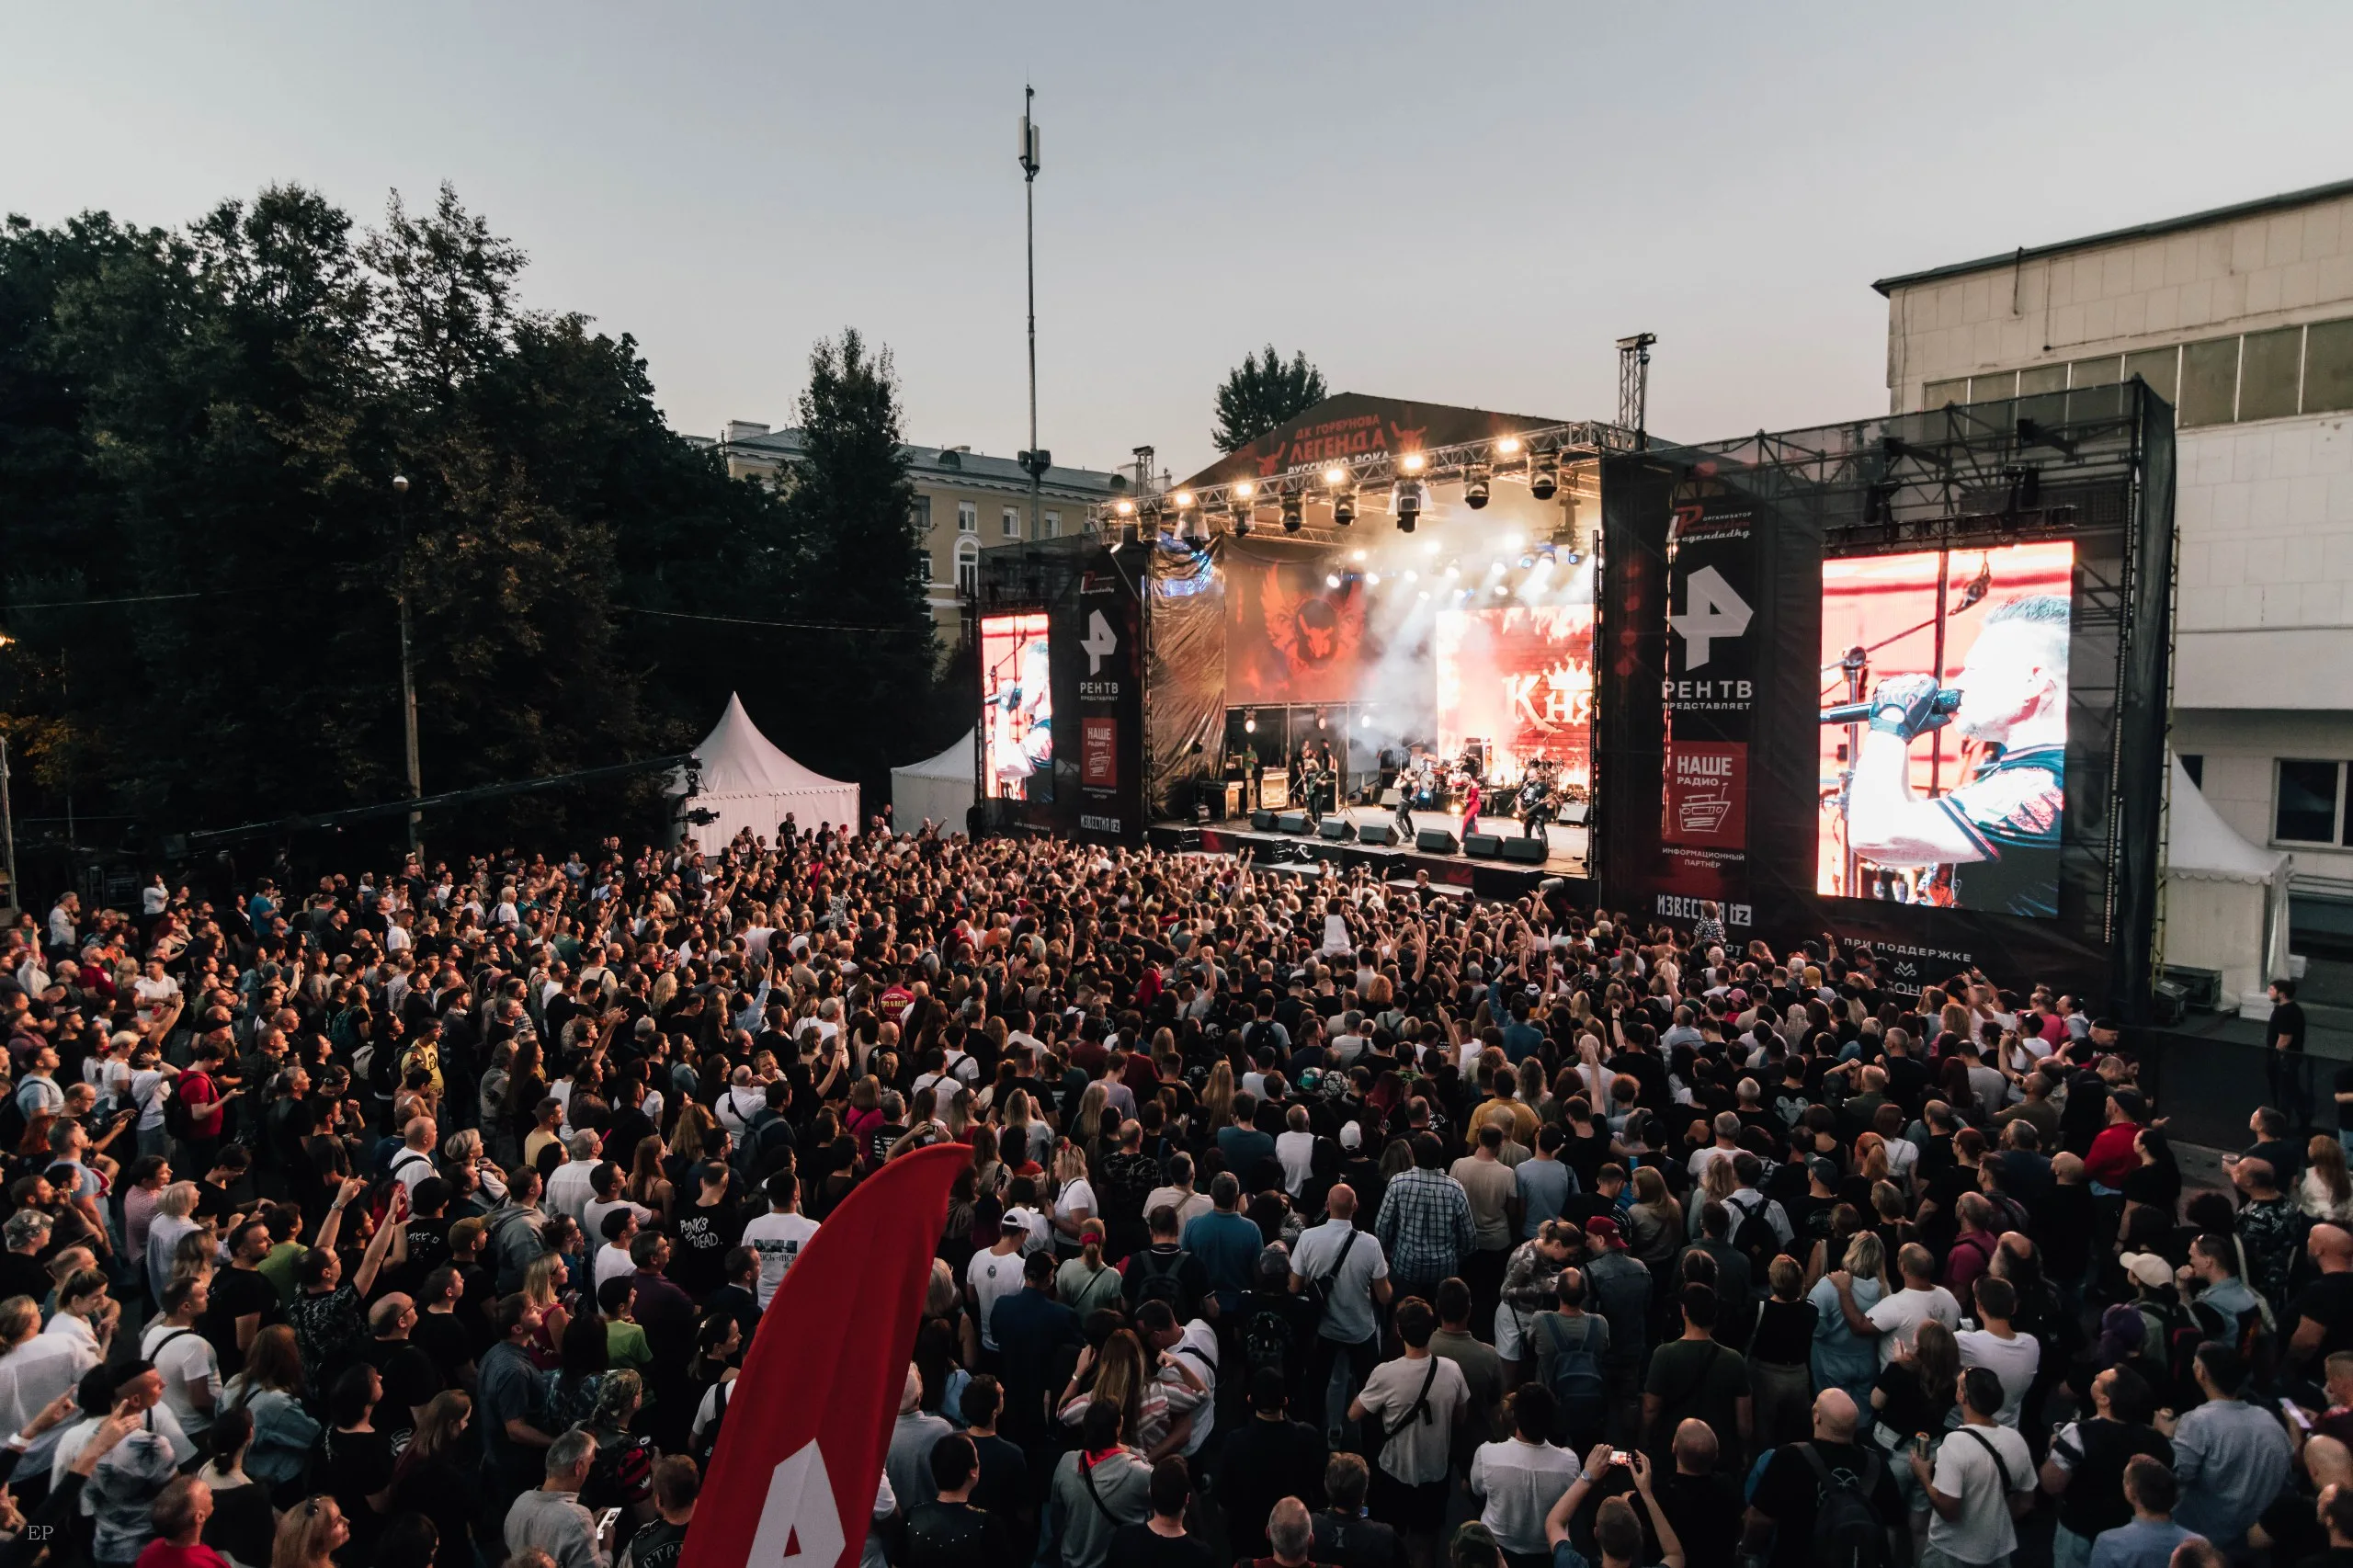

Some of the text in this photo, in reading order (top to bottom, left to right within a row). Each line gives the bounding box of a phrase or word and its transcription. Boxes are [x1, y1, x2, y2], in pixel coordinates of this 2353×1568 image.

[1290, 427, 1387, 464] ЛЕГЕНДА
[1287, 451, 1389, 474] РУССКОГО РОКА
[1080, 682, 1119, 694] РЕН ТВ
[1661, 681, 1753, 699] РЕН ТВ
[1662, 702, 1751, 710] ПРЕДСТАВЛЯЕТ
[1087, 727, 1111, 740] НАШЕ
[1677, 756, 1733, 776] НАШЕ
[1677, 777, 1719, 788] РАДИО
[1080, 814, 1109, 832] ИЗВЕСТИЯ
[1662, 847, 1745, 861] ИНФОРМАЦИОННЫЙ
[1657, 894, 1725, 923] ИЗВЕСТЯ
[1844, 937, 1972, 962] ПРИ ПОДДЕРЖКЕ
[680, 1216, 709, 1233] PUNKS
